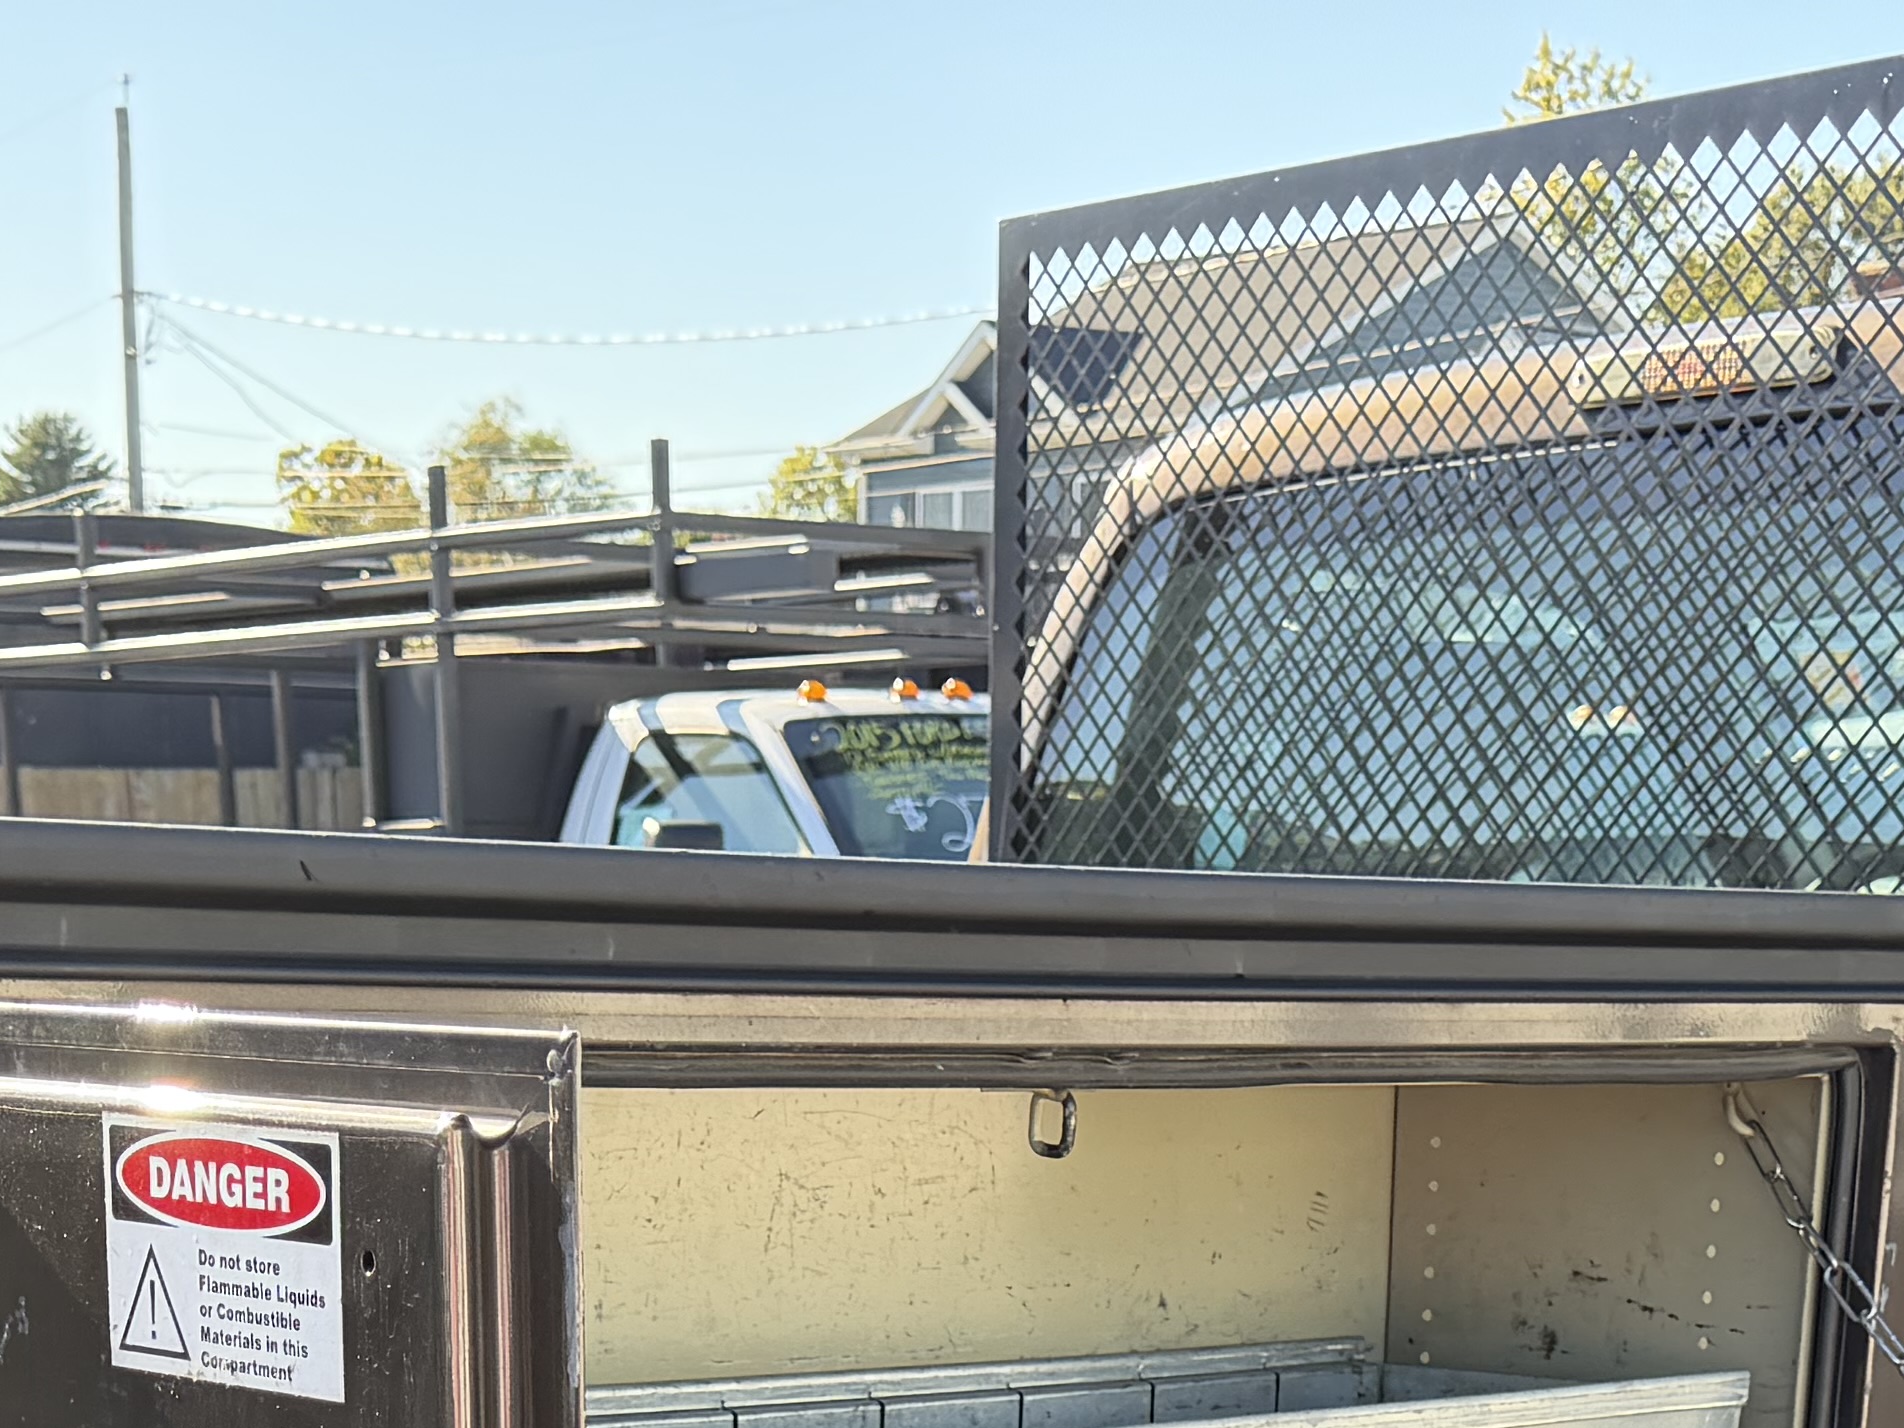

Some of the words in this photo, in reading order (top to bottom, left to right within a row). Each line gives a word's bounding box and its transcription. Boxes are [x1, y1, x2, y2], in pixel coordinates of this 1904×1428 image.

[148, 1154, 291, 1214] DANGER
[198, 1248, 215, 1267] Do
[219, 1253, 241, 1271] not
[245, 1257, 280, 1276] store
[198, 1274, 272, 1300] Flammable
[276, 1284, 326, 1309] Liquids
[199, 1304, 213, 1318] or
[216, 1303, 301, 1331] Combustible
[200, 1325, 262, 1351] Materials
[266, 1336, 279, 1353] in
[282, 1339, 309, 1359] this
